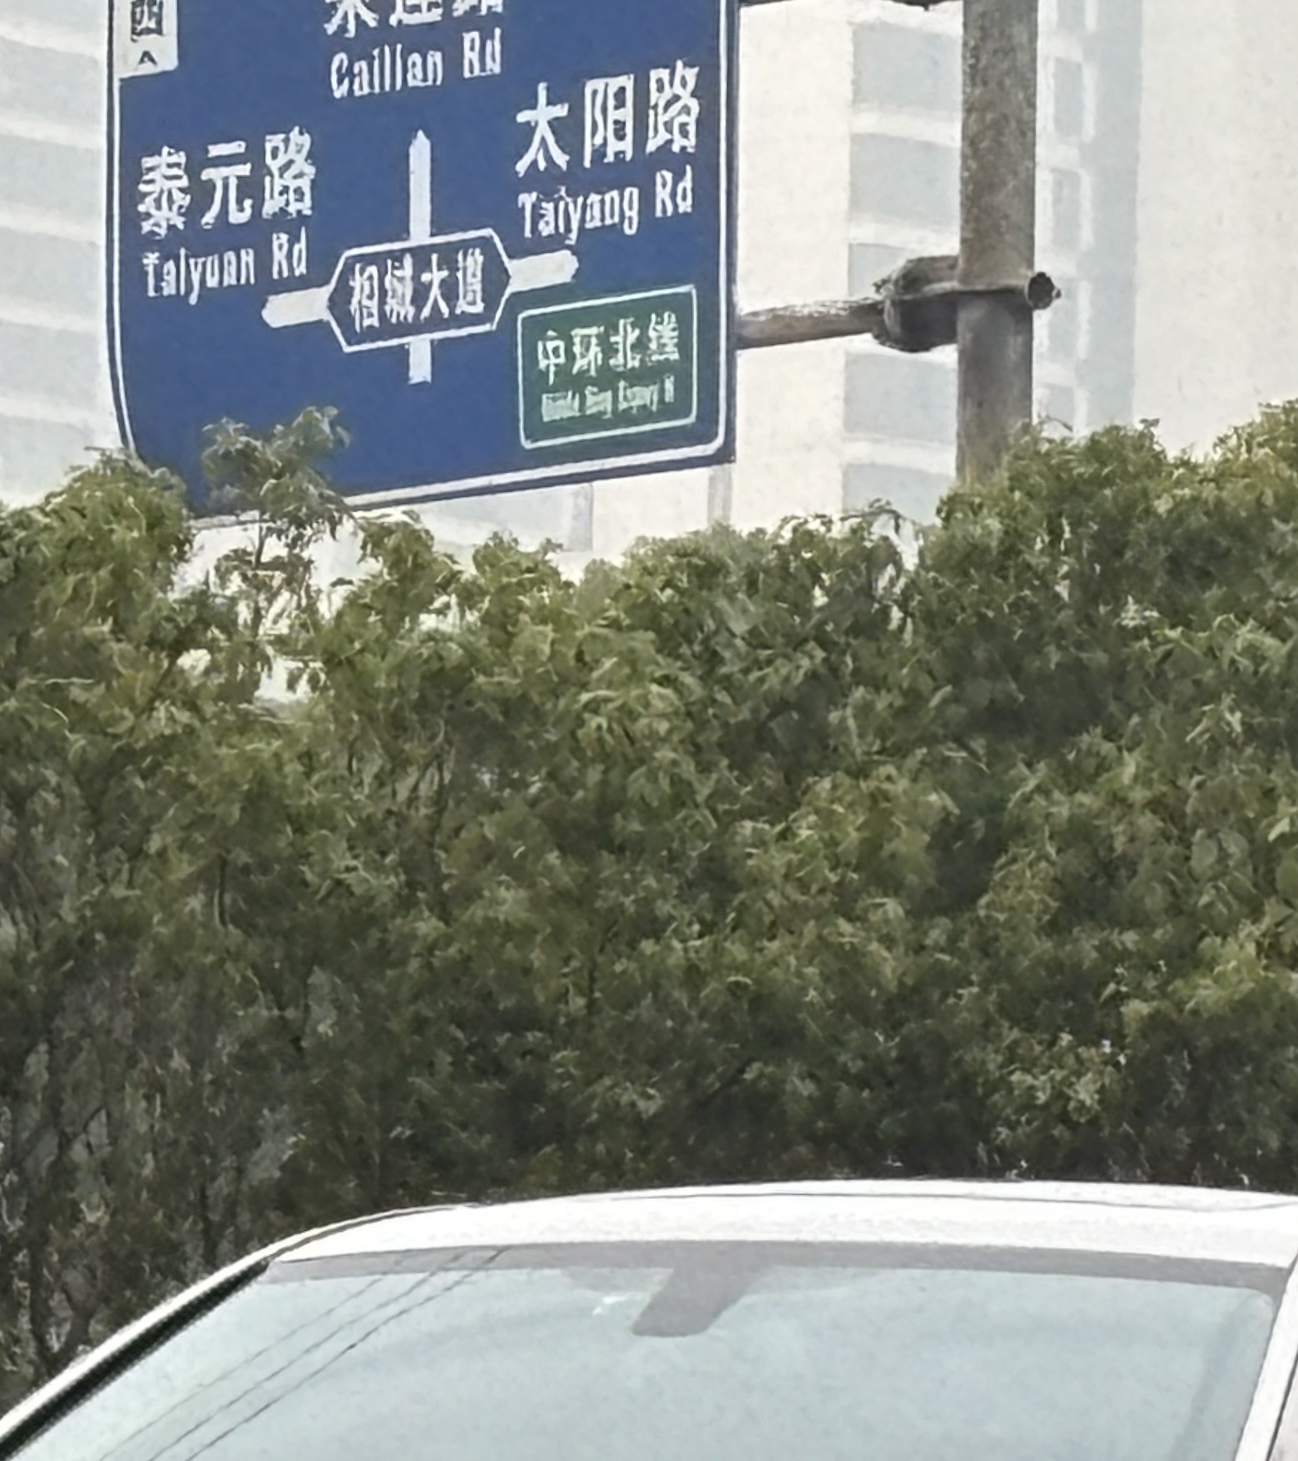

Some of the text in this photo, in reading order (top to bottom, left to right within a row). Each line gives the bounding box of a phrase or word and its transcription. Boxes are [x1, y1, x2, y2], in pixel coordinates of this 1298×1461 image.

[330, 27, 502, 99] Cailian Rd
[515, 58, 700, 178] 太阳路
[137, 126, 316, 240] 泰元路
[518, 164, 693, 245] Taiyang Rd
[142, 226, 307, 305] Taiyuan Rd
[349, 247, 485, 333] 相城大道
